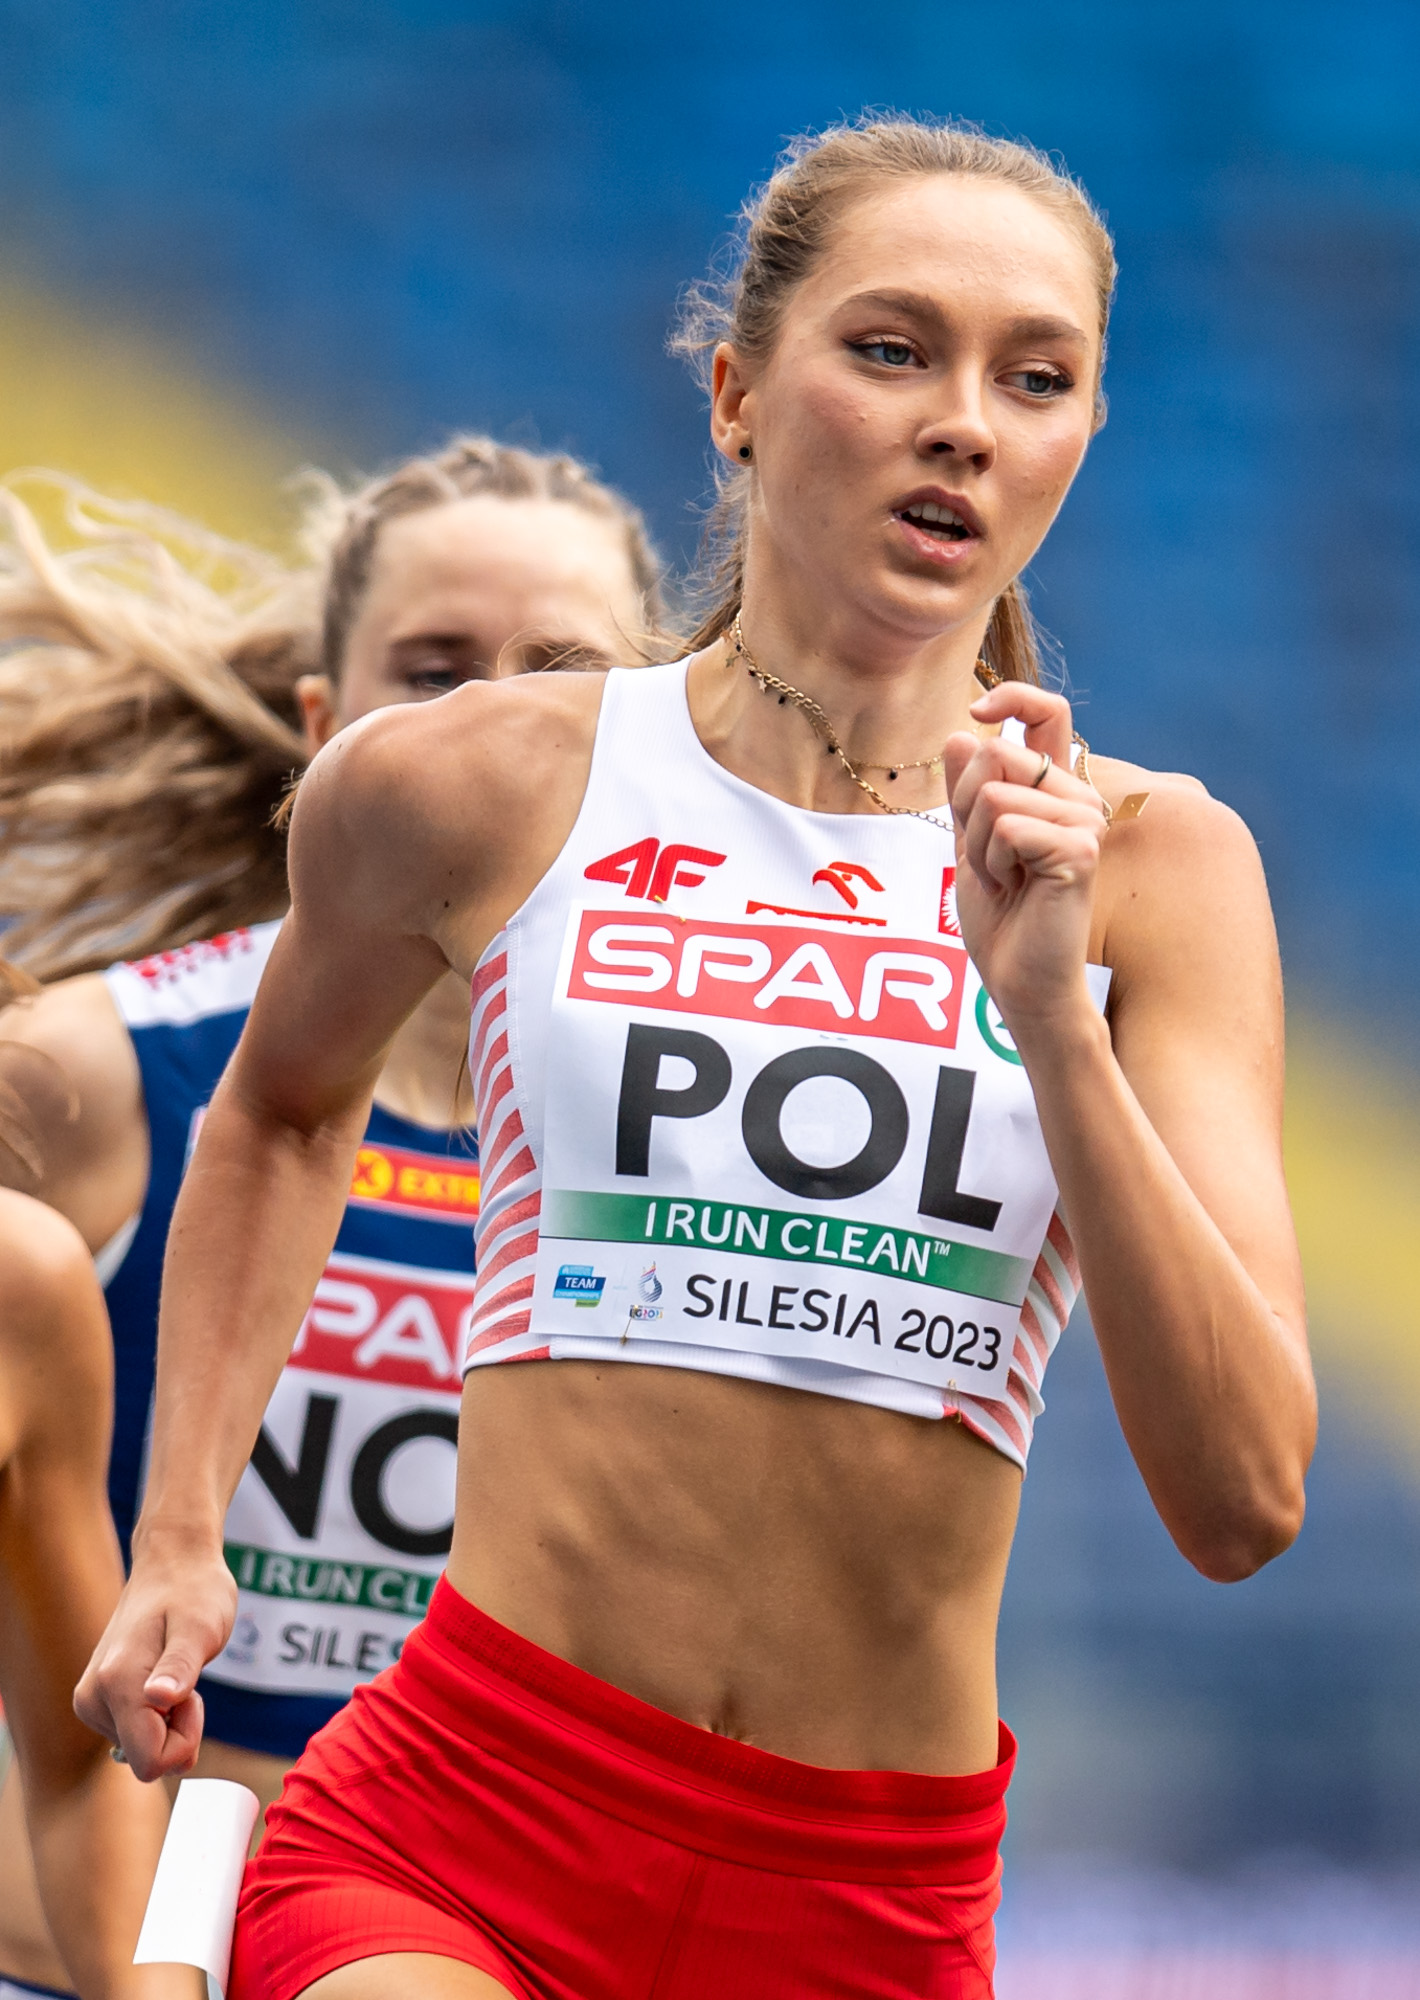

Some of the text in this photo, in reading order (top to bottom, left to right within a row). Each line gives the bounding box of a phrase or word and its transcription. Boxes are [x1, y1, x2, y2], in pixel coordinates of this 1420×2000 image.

[583, 837, 727, 901] 4F
[583, 924, 953, 1031] SPAR
[615, 1022, 1003, 1231] POL
[645, 1201, 657, 1238] I
[665, 1202, 770, 1250] RUN
[565, 1277, 597, 1289] TEAM
[682, 1273, 1000, 1371] SILESIA 2023
[293, 1281, 473, 1381] PA
[240, 1552, 441, 1612] I RUN CL
